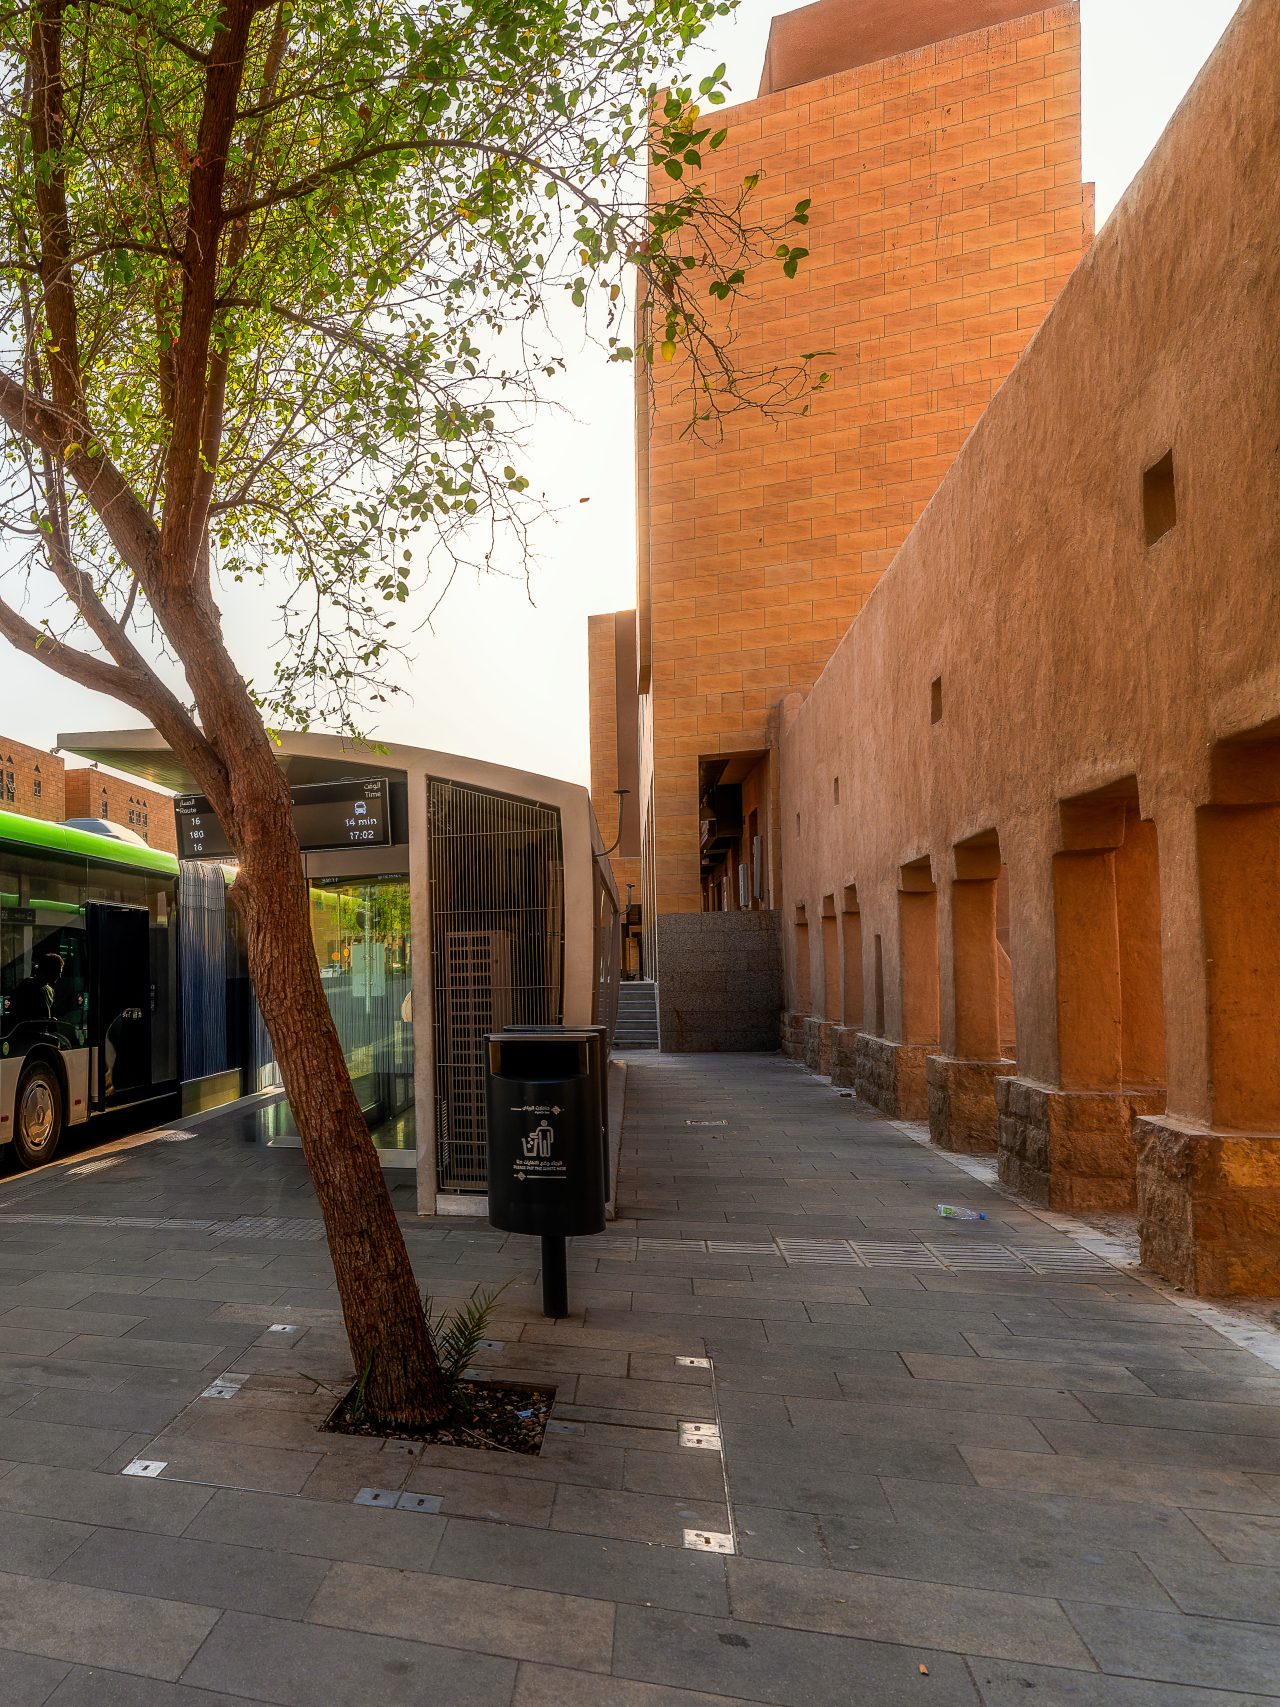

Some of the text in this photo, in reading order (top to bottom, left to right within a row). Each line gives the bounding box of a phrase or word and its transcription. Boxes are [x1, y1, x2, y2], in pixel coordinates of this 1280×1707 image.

[364, 782, 381, 790] الوقت
[191, 817, 201, 826] 16
[345, 817, 377, 827] 14 min
[349, 830, 374, 840] 17:02
[194, 843, 203, 852] 16
